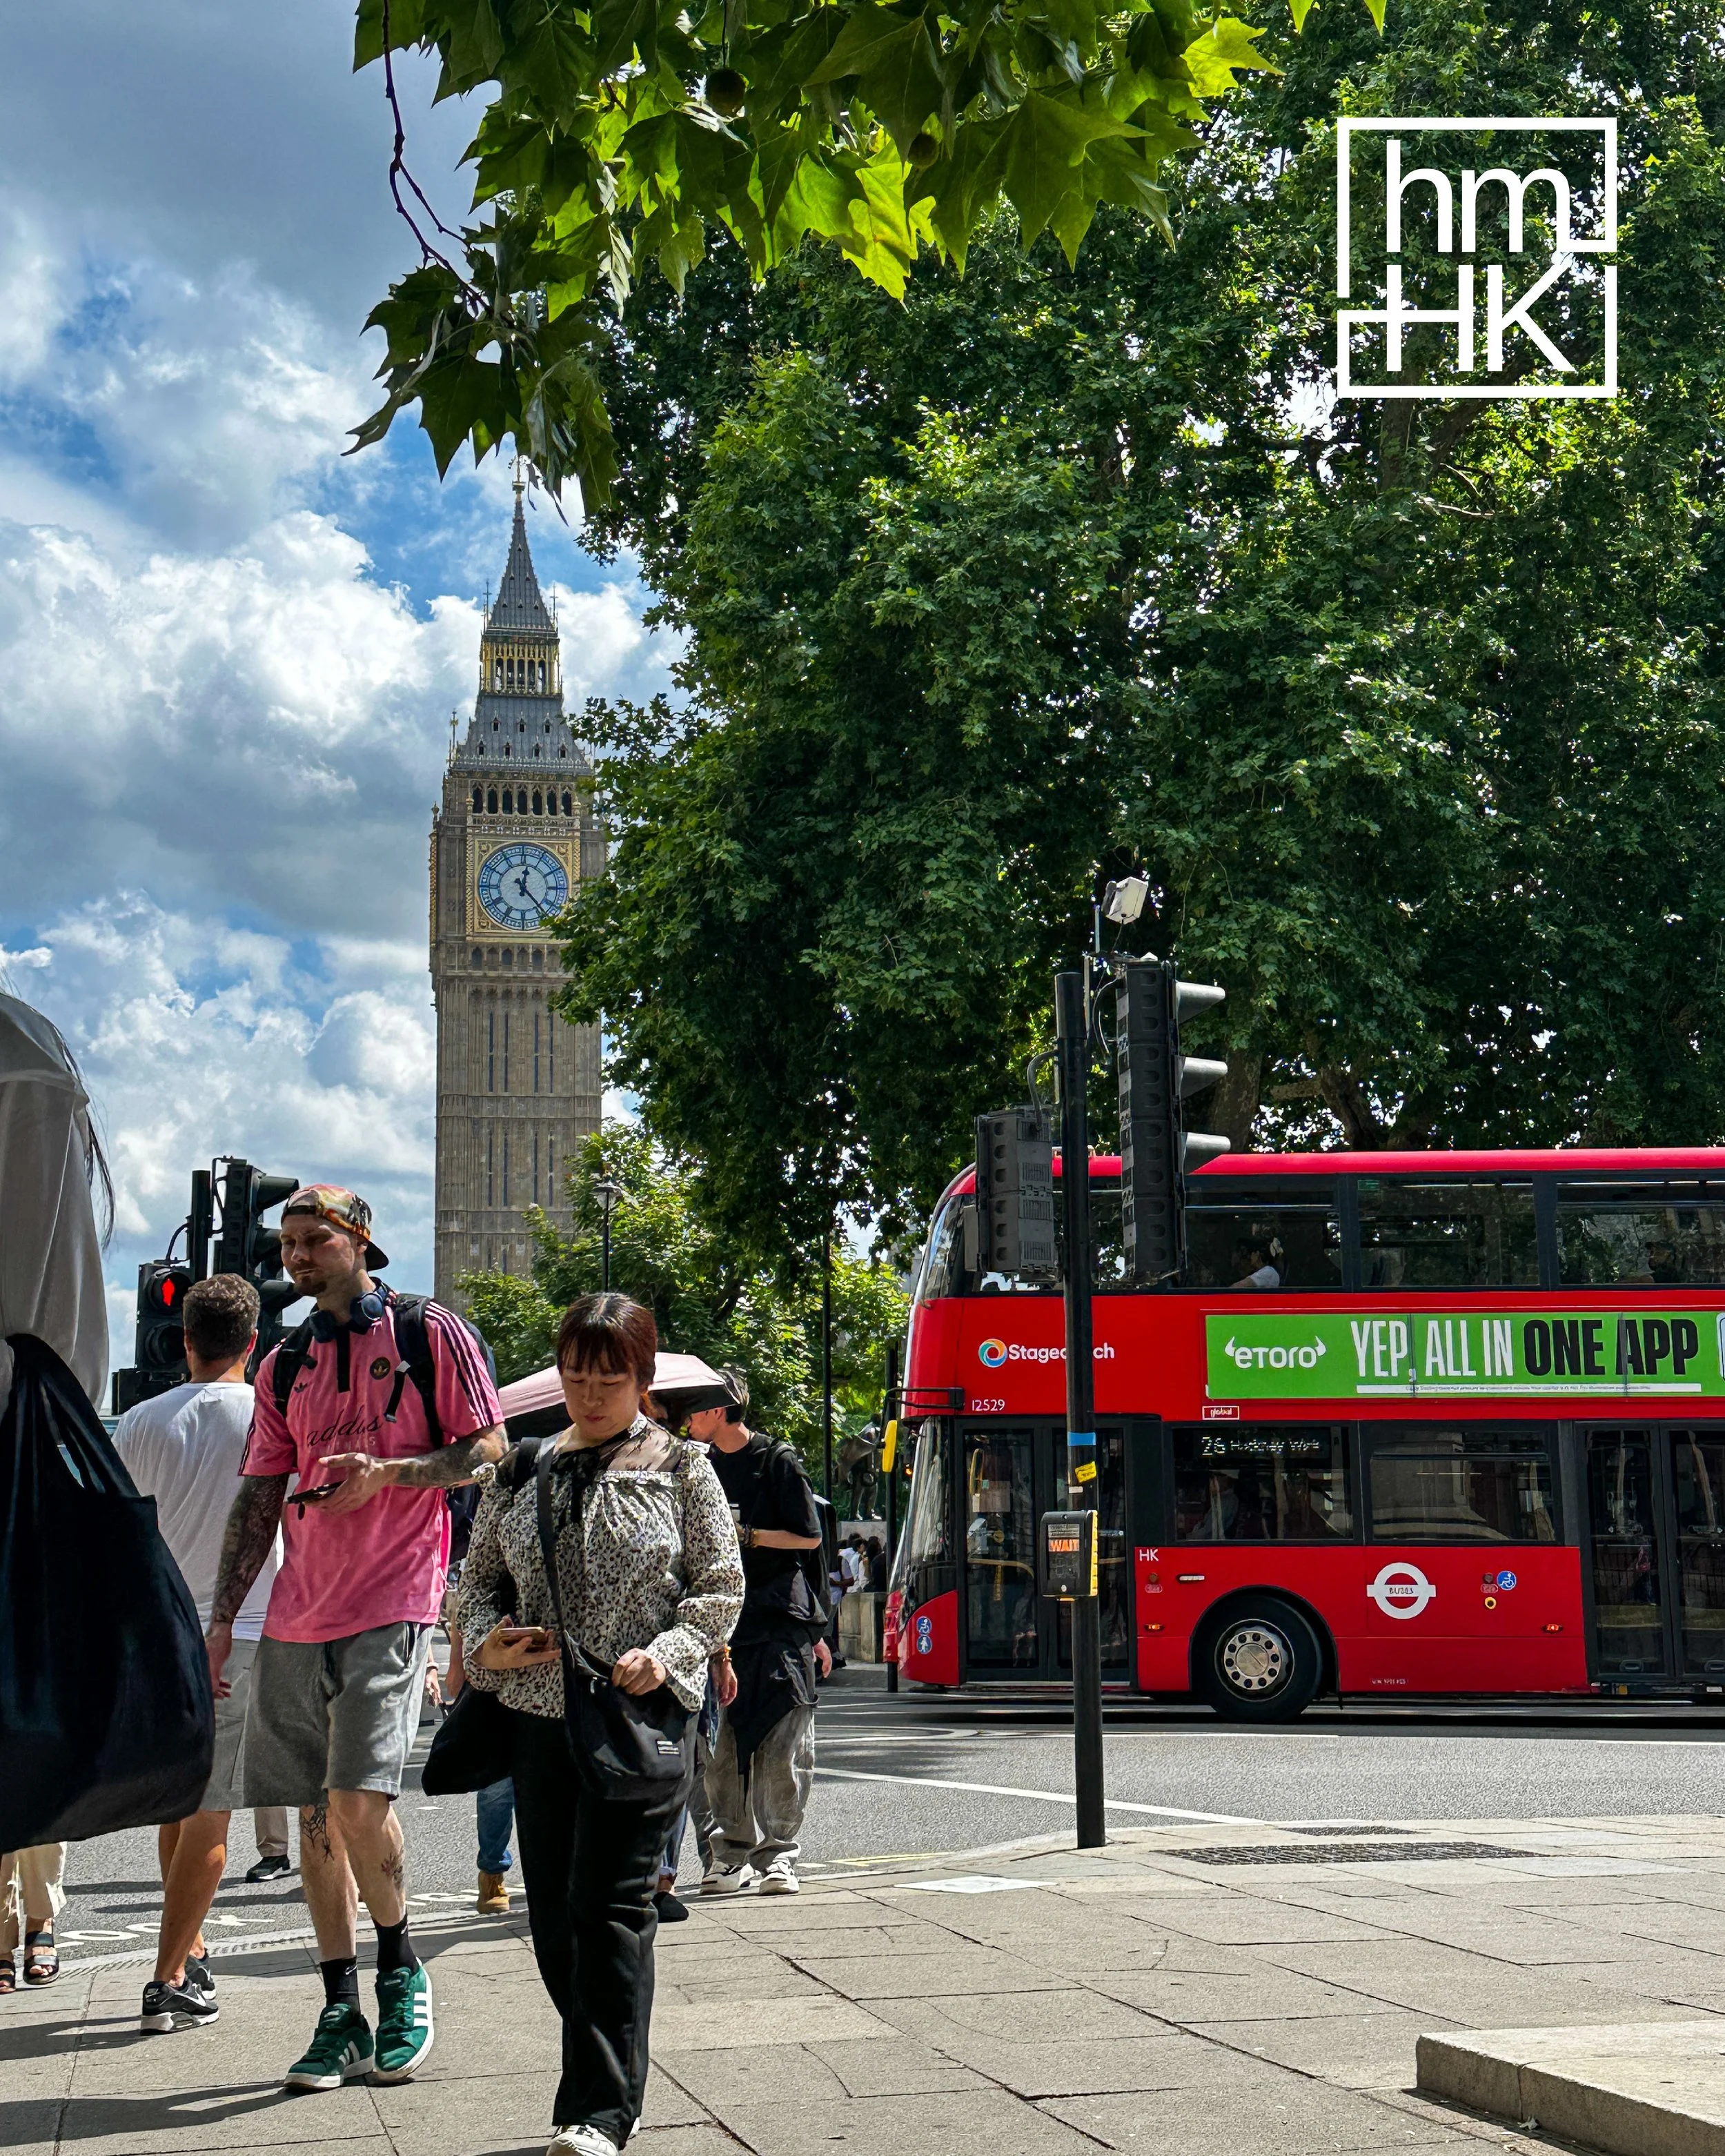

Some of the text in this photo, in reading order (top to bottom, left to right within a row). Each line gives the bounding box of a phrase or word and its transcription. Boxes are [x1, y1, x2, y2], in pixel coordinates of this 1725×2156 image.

[1008, 1342, 1115, 1364] Stagecch
[1426, 1320, 1477, 1376] ALL
[1482, 1320, 1514, 1376] IN
[1524, 1319, 1606, 1376] ONE
[1615, 1318, 1699, 1376] APP
[972, 1398, 1005, 1412] 12529
[1201, 1437, 1225, 1456] 26
[1049, 1539, 1078, 1552] WAIT
[1138, 1549, 1159, 1562] HK
